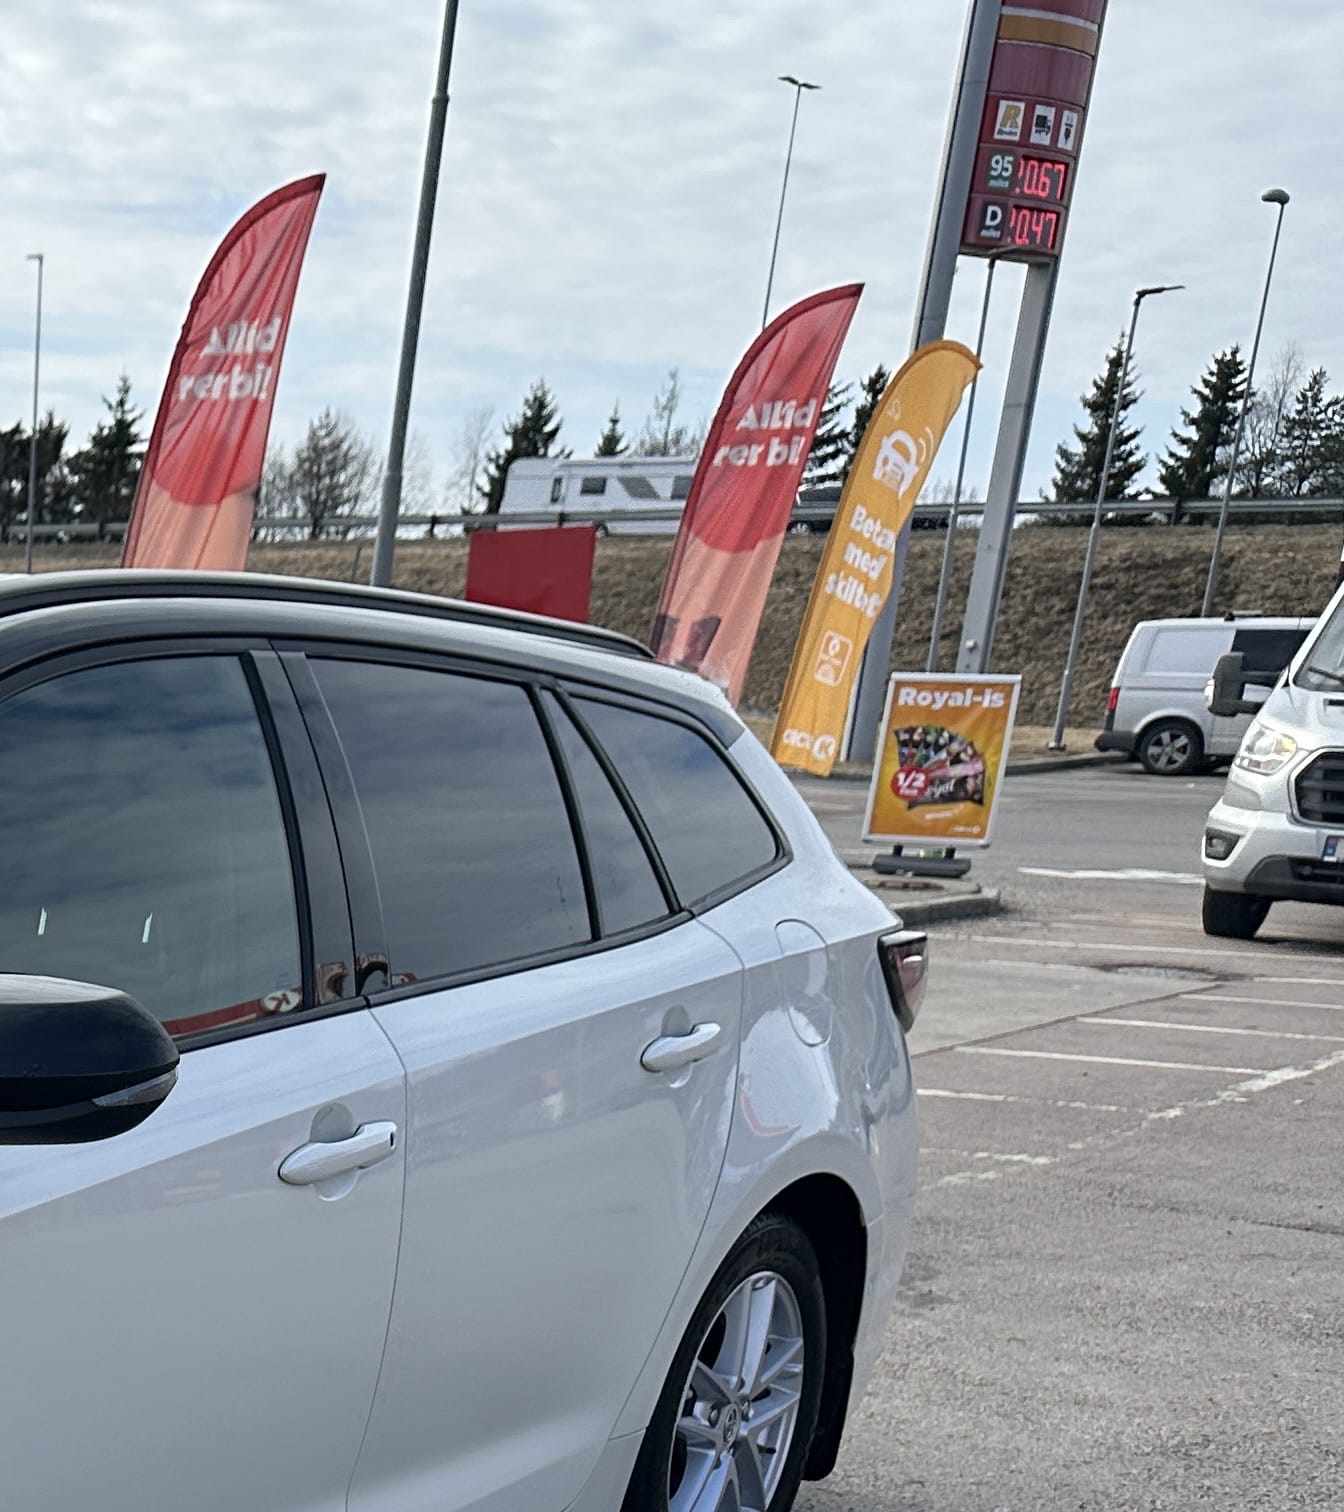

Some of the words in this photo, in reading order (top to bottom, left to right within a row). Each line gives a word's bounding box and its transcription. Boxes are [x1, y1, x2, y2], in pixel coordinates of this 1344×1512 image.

[990, 154, 1014, 177] 95
[985, 205, 1002, 227] D
[843, 541, 889, 580] med
[897, 687, 1005, 710] Royal-is
